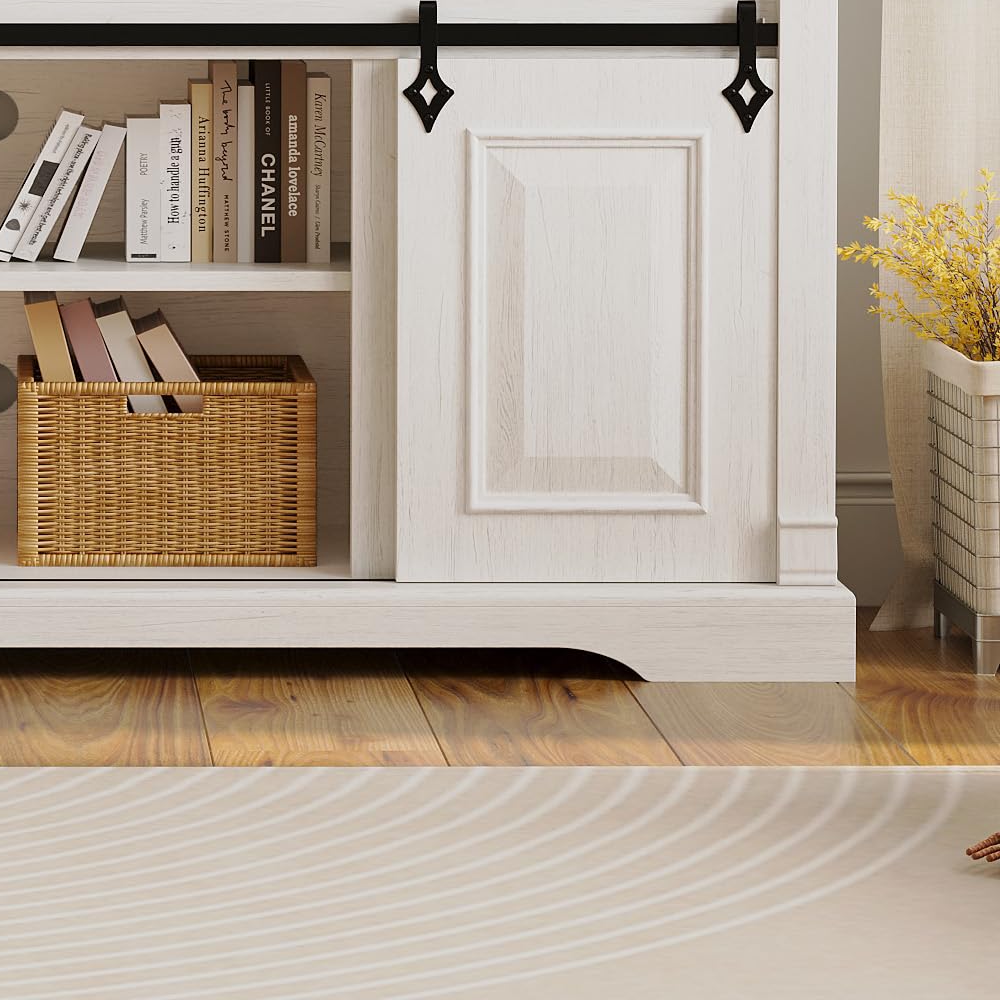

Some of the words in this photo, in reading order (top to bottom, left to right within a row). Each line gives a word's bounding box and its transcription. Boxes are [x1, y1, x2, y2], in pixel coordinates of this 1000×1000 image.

[220, 80, 233, 105] The
[314, 92, 327, 122] Karen
[170, 137, 182, 154] gun
[199, 116, 211, 162] Arianna
[265, 127, 271, 136] OF
[288, 115, 301, 163] amanda
[139, 153, 148, 176] POETRY
[215, 141, 233, 181] beyond
[311, 124, 327, 177] McCartney
[167, 162, 180, 192] handle
[288, 167, 301, 217] lovelace
[139, 198, 150, 218] Parsley
[168, 193, 180, 202] to
[195, 168, 211, 232] Huffington
[261, 153, 276, 237] CHANEL
[167, 204, 180, 224] How
[139, 219, 148, 245] Matthew
